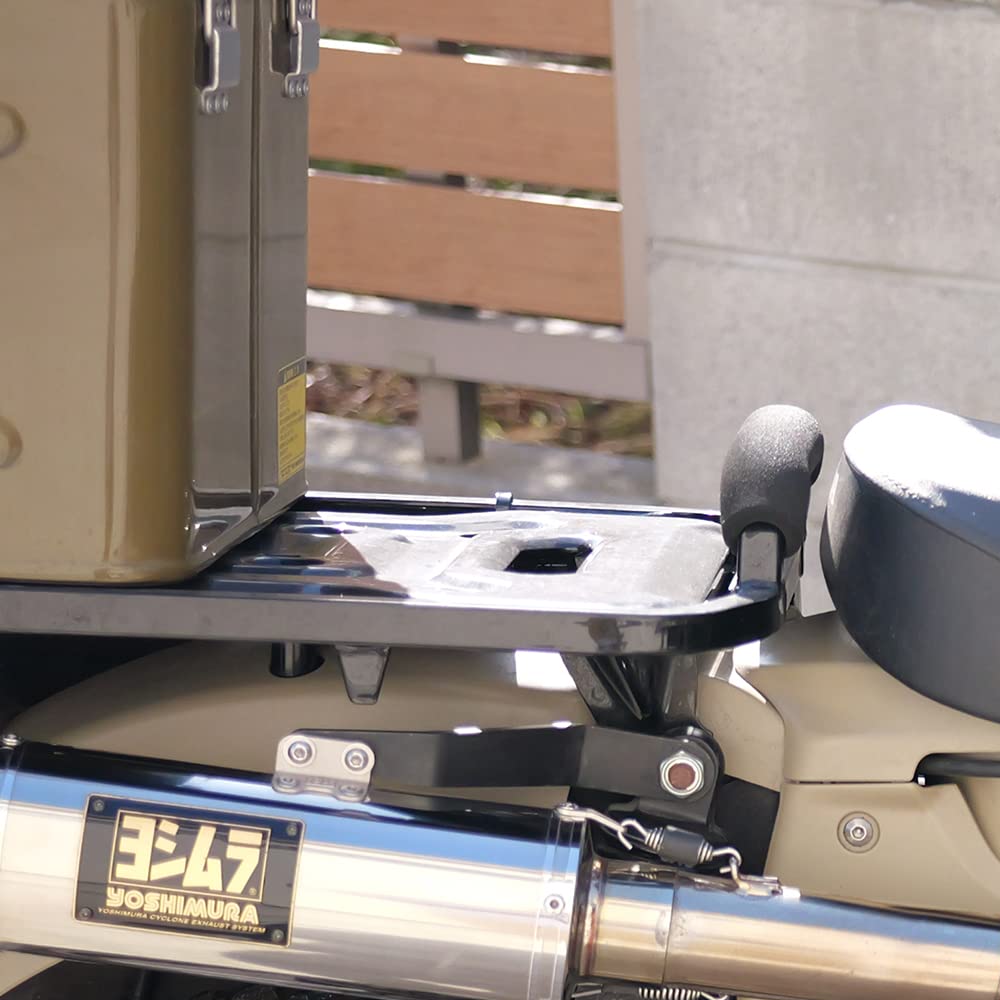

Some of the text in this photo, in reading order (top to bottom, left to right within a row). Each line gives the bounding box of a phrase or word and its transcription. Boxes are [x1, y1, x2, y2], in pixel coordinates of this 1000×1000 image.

[116, 814, 263, 894] ヨシムラ
[98, 907, 266, 934] YOSHIMURA CYCLONE EXHAUST SYSTEM
[106, 887, 259, 925] YOSHIMURA
